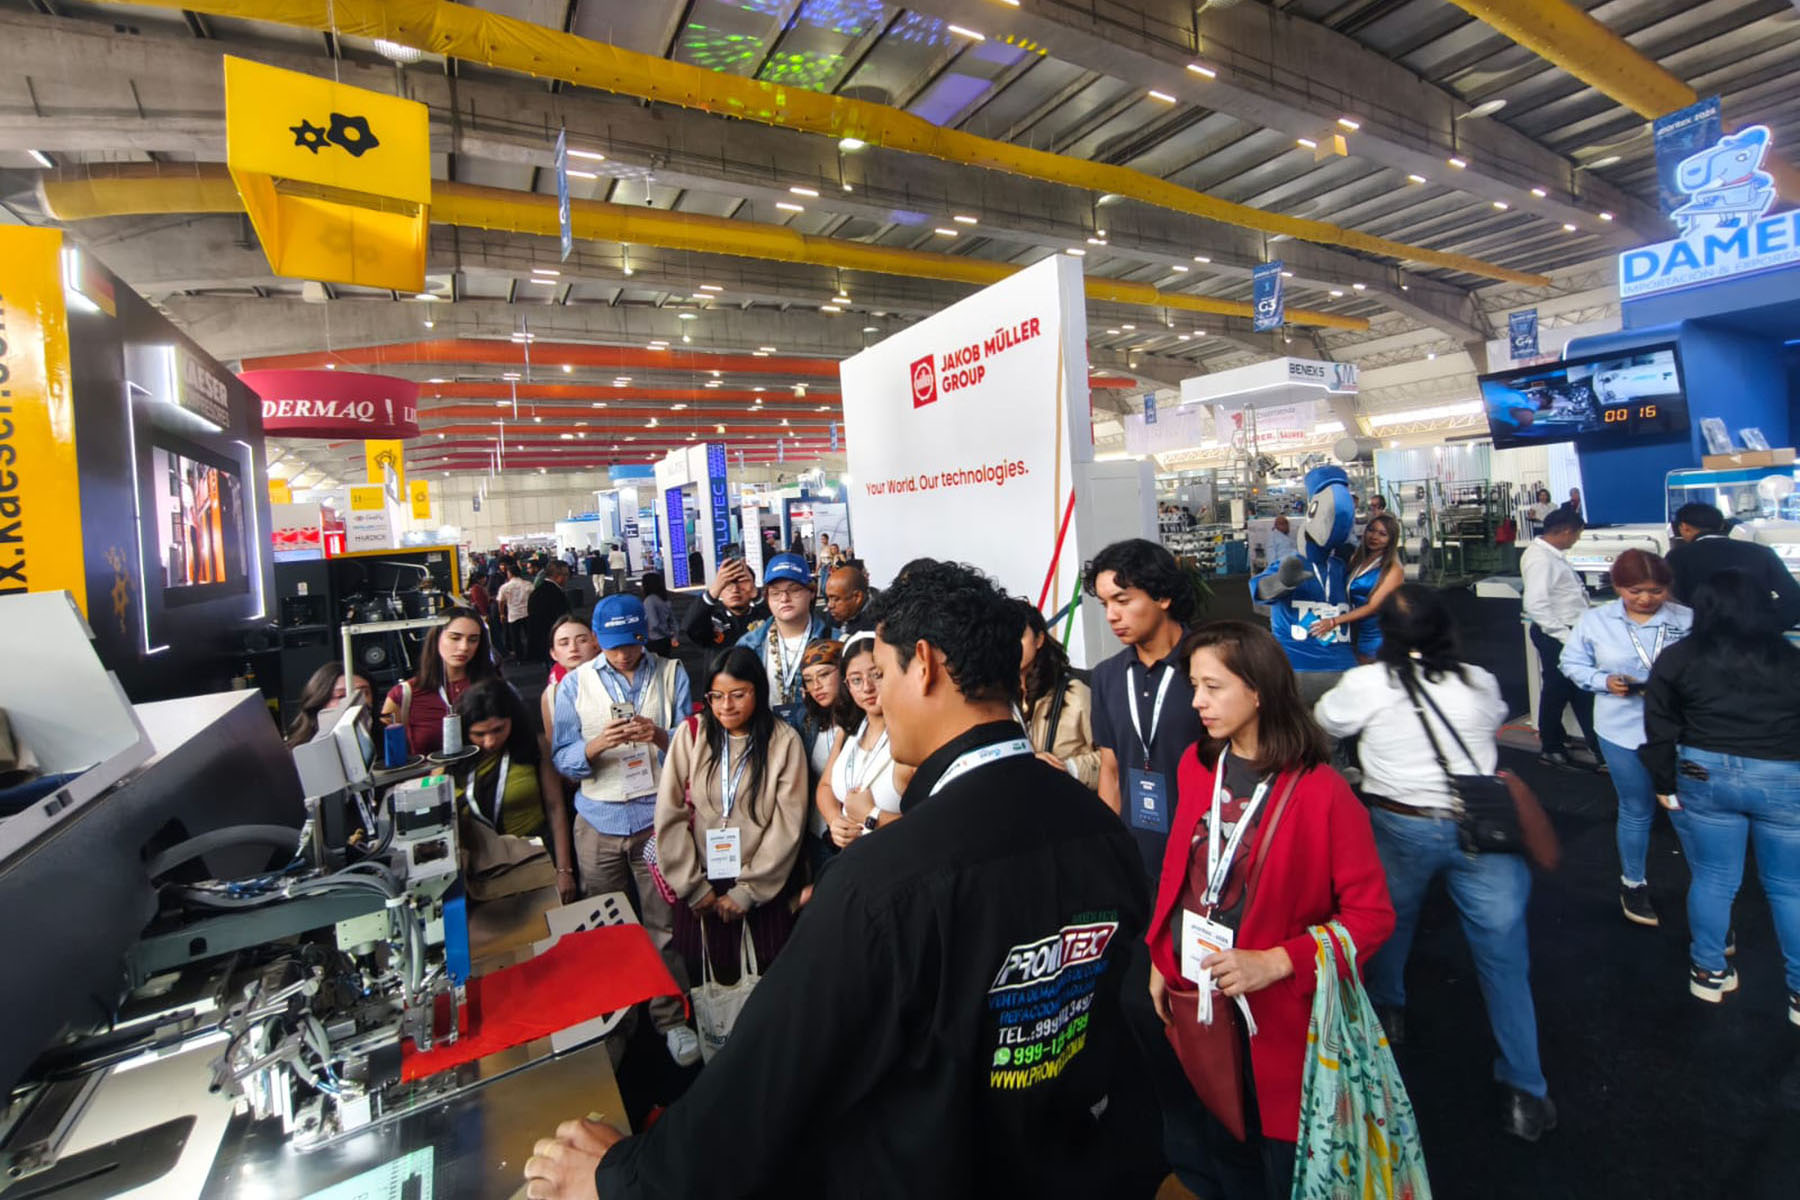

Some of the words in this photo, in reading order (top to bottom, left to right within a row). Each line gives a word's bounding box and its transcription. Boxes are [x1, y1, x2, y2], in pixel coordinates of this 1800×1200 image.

[1258, 299, 1276, 313] G3
[941, 344, 980, 373] JAKOB
[942, 365, 985, 393] GROUP
[866, 482, 885, 496] Your
[886, 476, 917, 494] World.
[919, 474, 939, 491] Our
[941, 459, 1029, 487] technologies.
